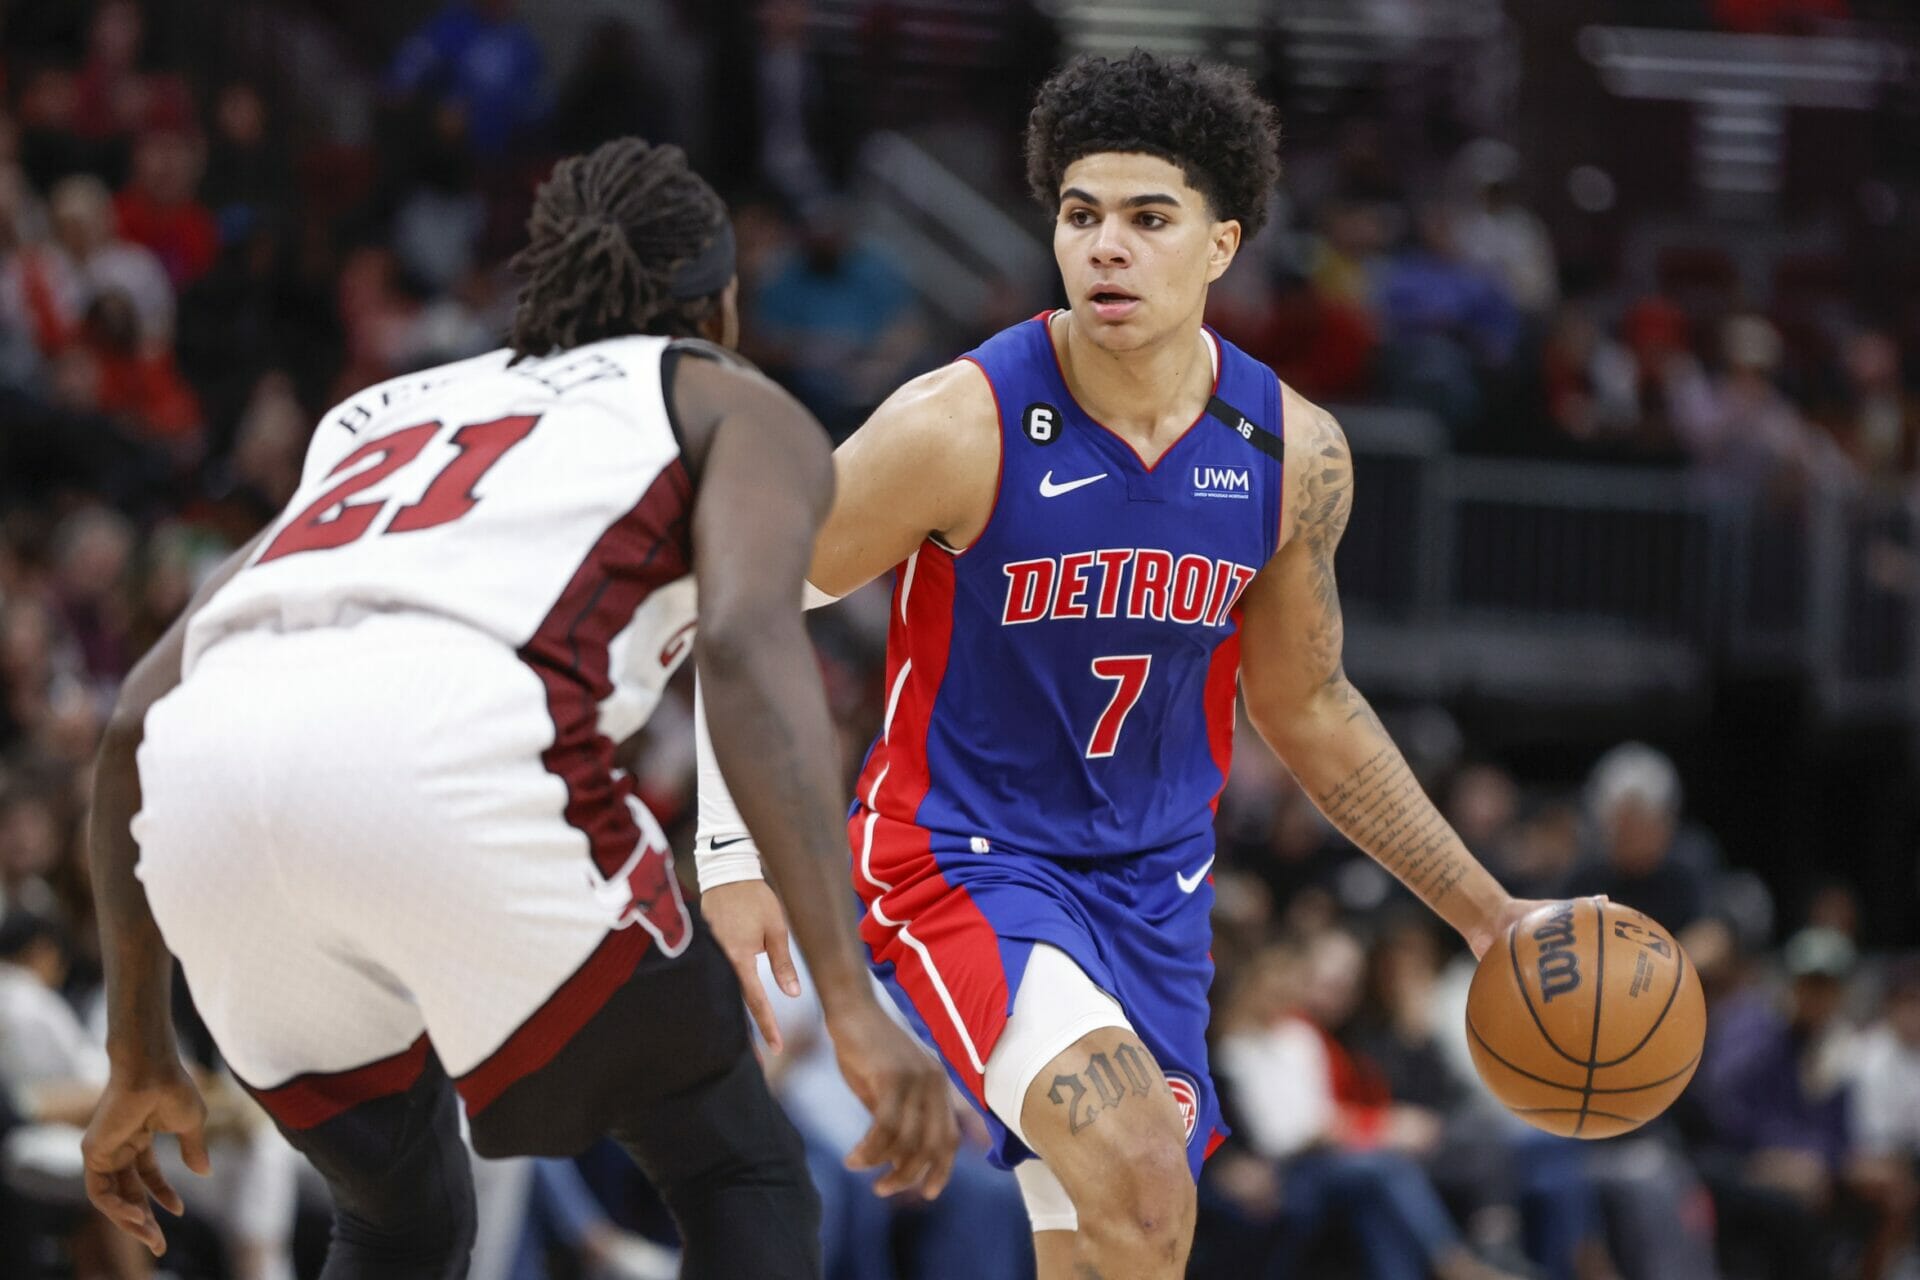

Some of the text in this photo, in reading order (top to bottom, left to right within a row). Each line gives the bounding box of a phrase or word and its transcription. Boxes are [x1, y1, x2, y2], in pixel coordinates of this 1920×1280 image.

[1030, 407, 1053, 441] 6
[1236, 417, 1254, 440] 16
[254, 413, 544, 568] 21
[1194, 466, 1249, 491] UWM
[1001, 548, 1257, 627] DETROIT
[1085, 654, 1152, 759] 7
[1048, 1042, 1160, 1136] 200
